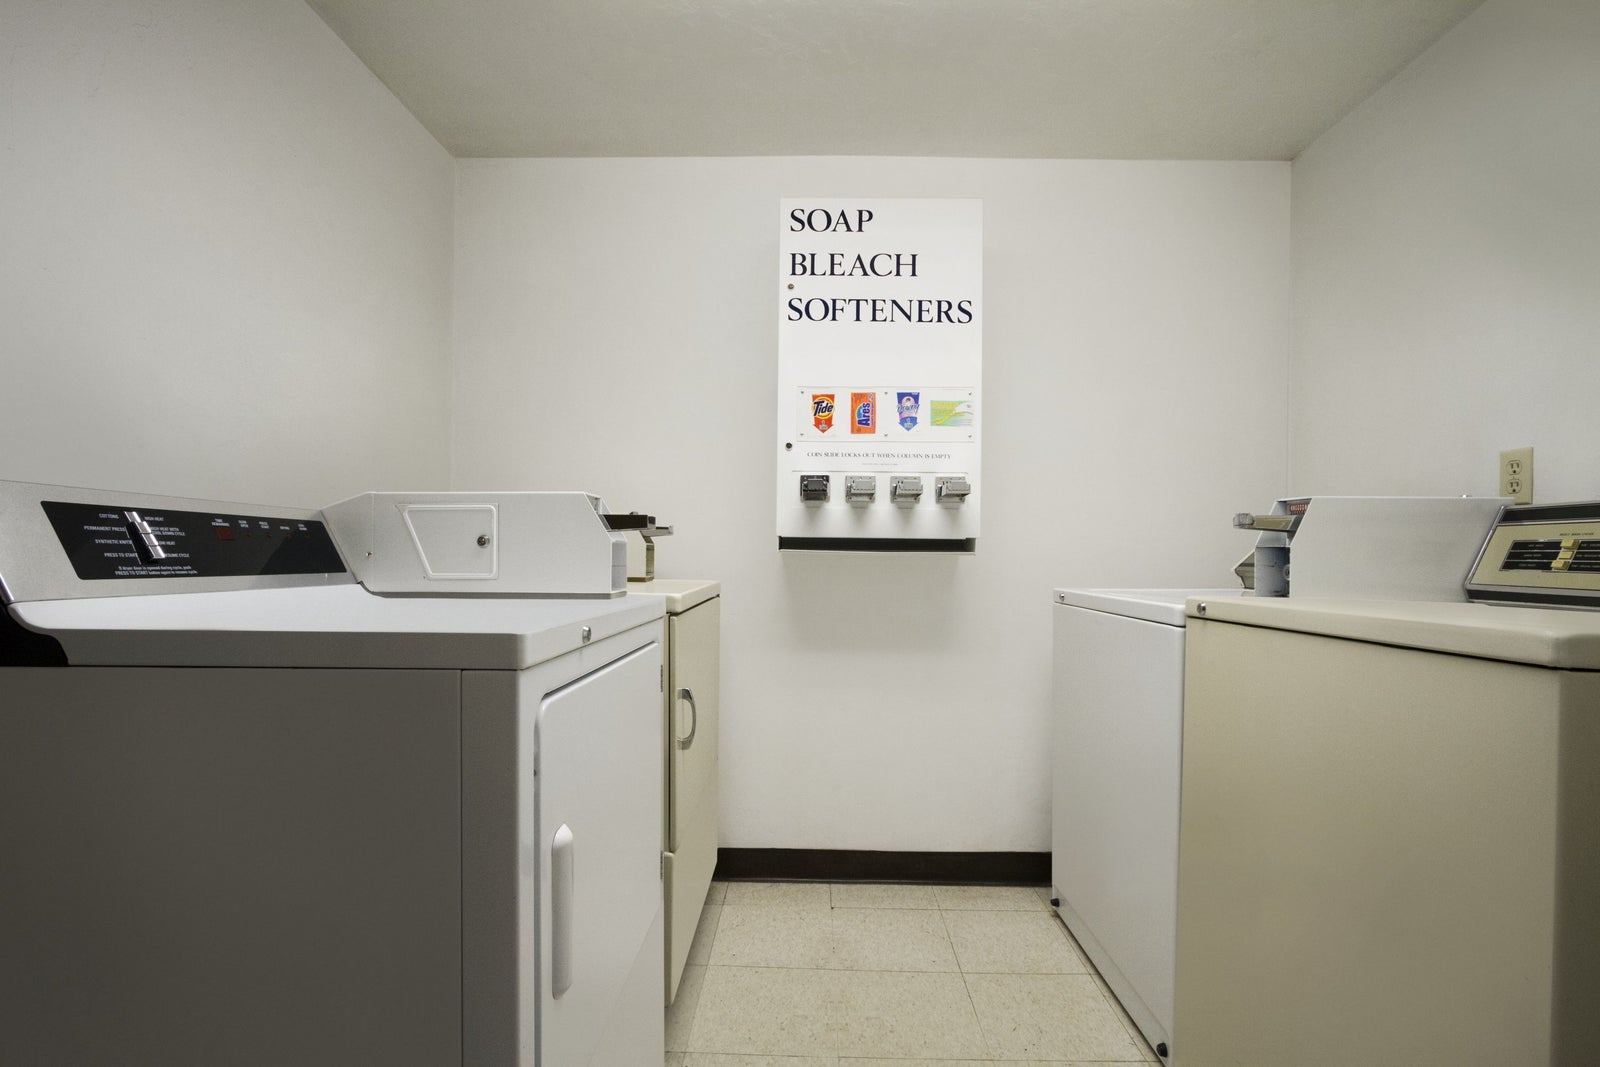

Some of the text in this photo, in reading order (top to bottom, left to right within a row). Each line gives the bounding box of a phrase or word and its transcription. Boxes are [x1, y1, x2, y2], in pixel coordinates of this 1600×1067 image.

[790, 208, 874, 232] SOAP
[789, 252, 919, 277] BLEACH
[787, 297, 973, 324] SOFTENERS
[813, 400, 834, 416] Tide
[857, 402, 871, 427] Ares
